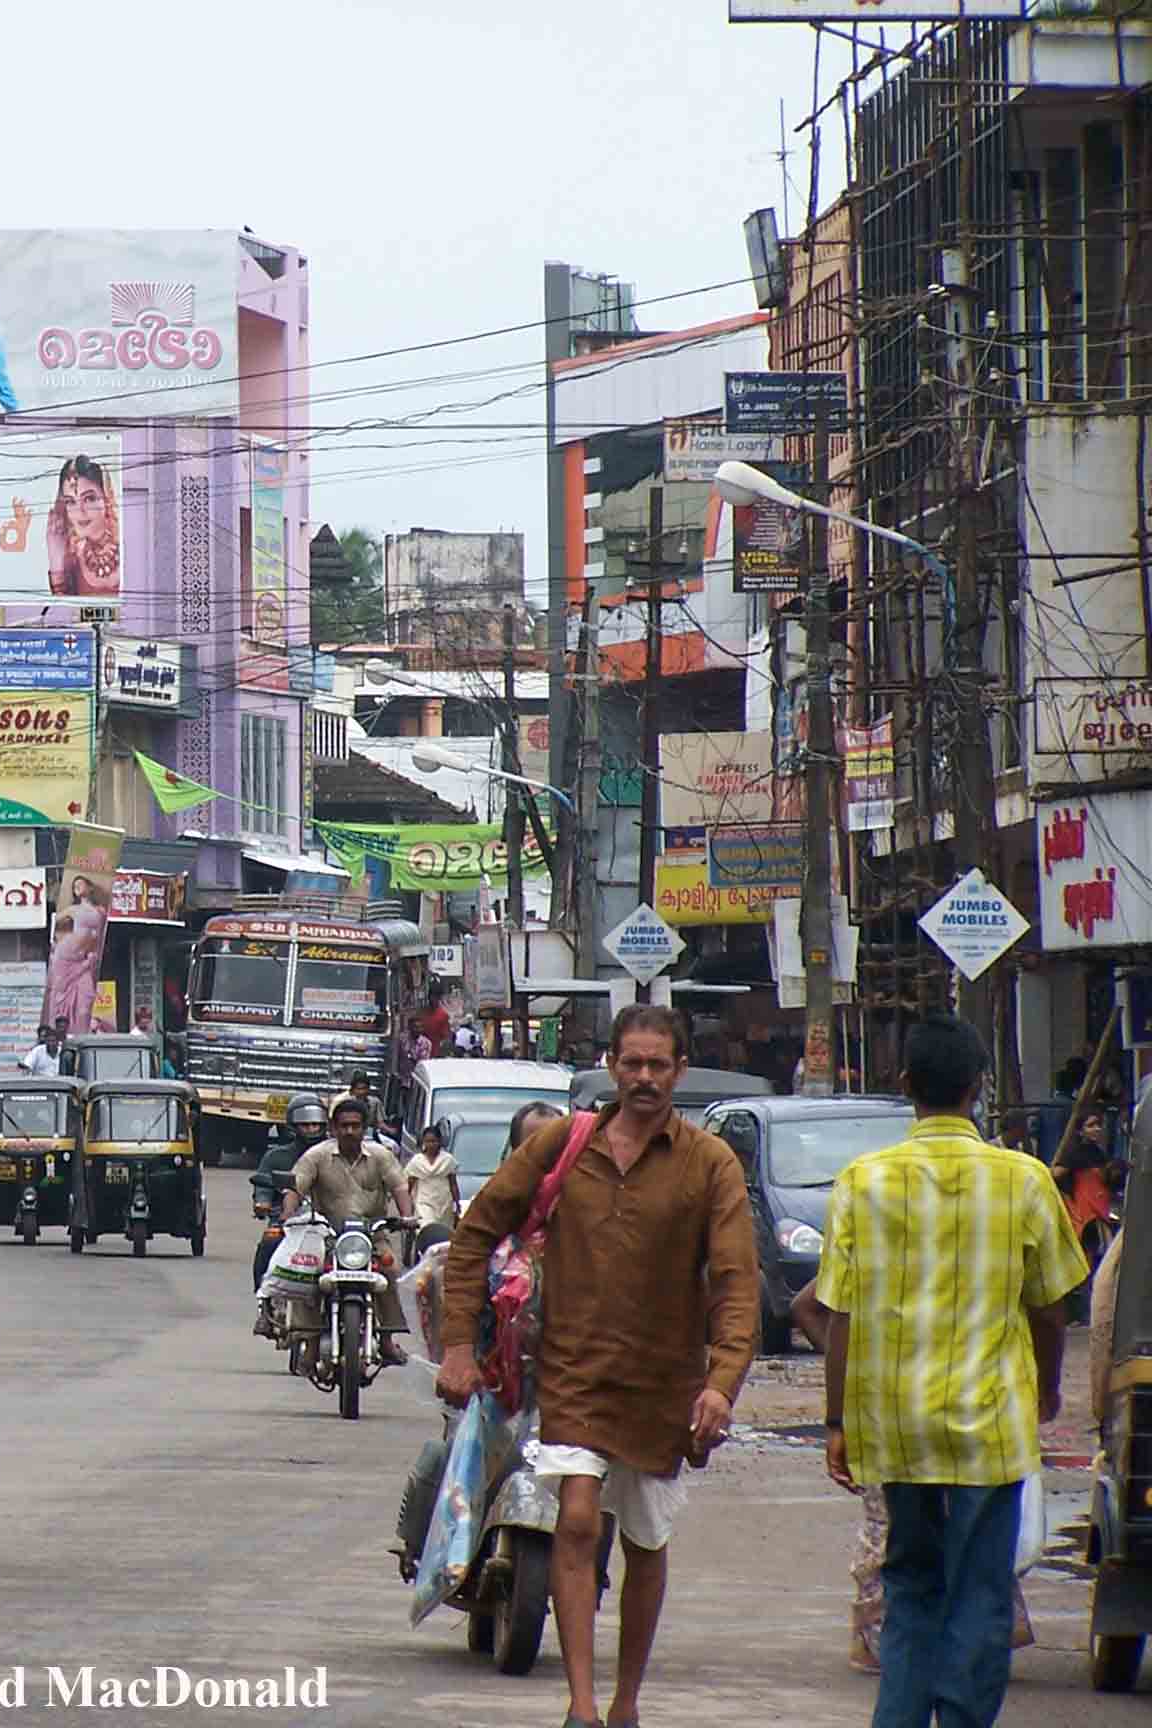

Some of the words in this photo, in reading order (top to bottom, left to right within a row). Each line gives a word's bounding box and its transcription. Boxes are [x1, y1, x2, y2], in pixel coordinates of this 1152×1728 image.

[690, 438, 723, 450] Home
[947, 899, 1002, 912] JUMBO
[942, 913, 1008, 925] MOBILES
[624, 926, 664, 935] JUMBO
[620, 936, 669, 945] MOBILES
[300, 1011, 376, 1023] CHALAKUDY
